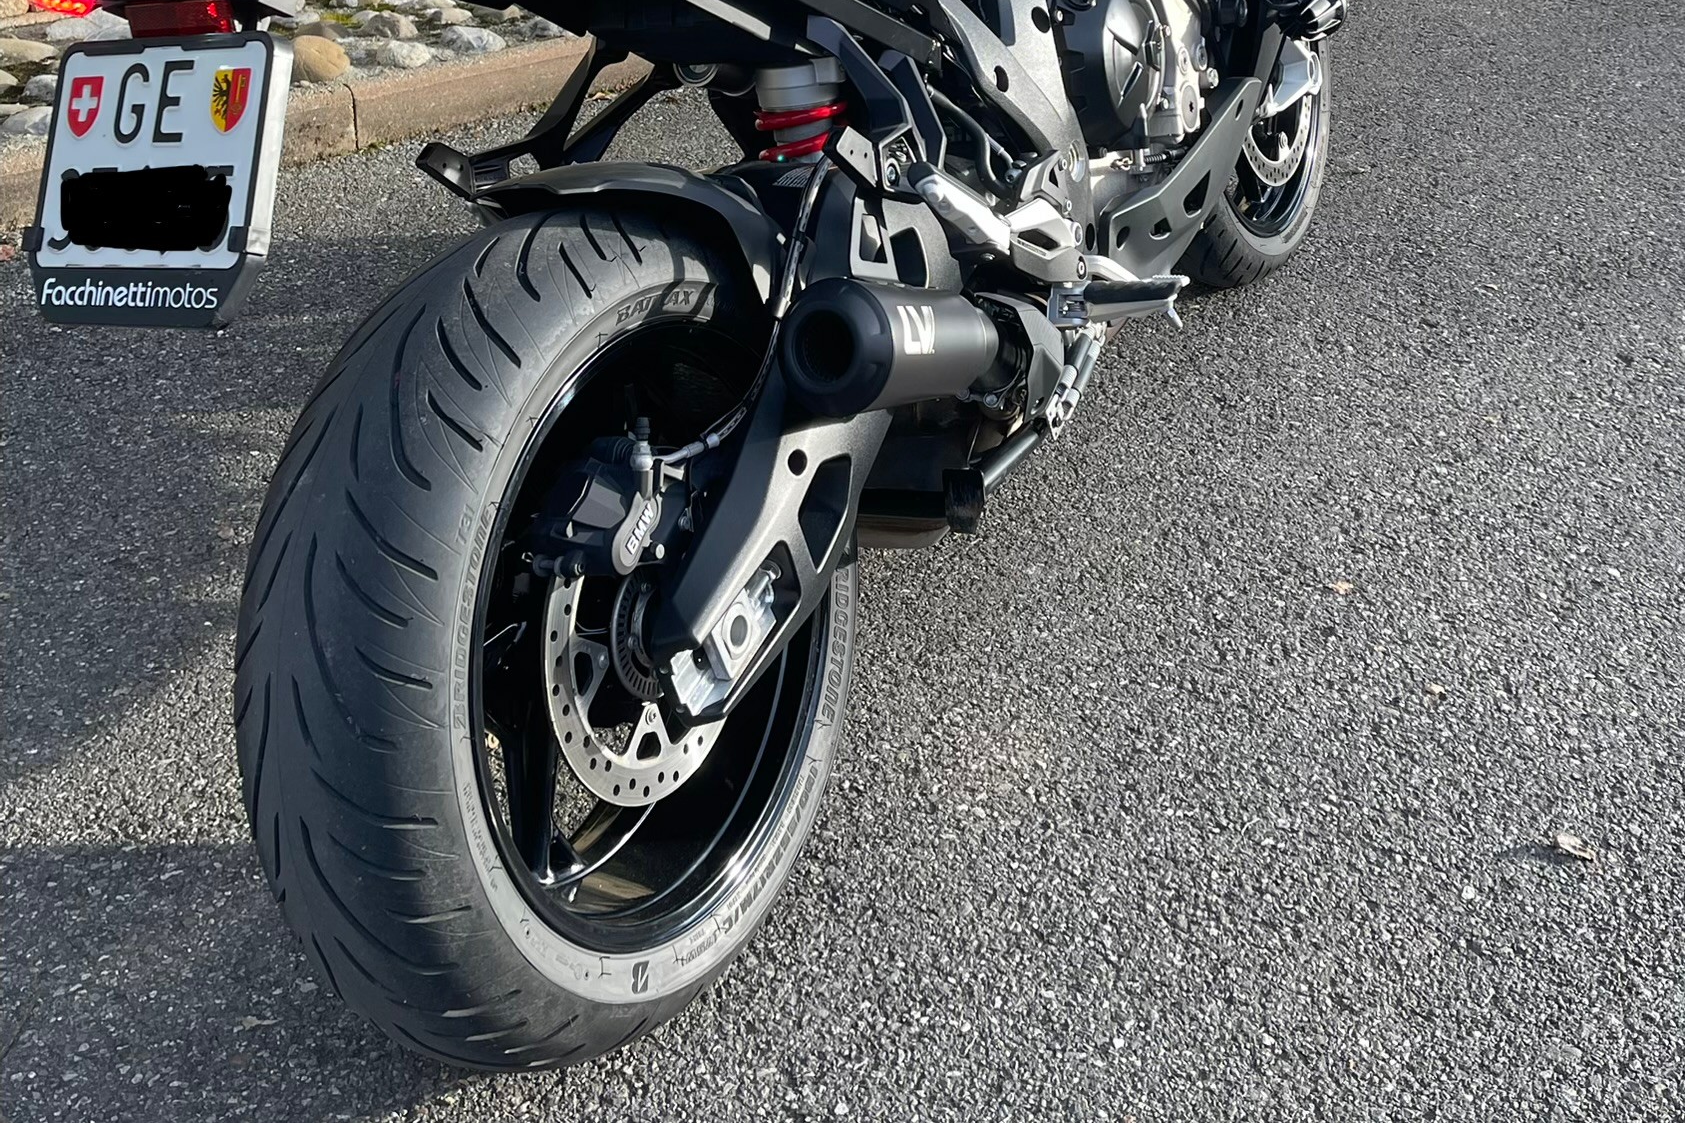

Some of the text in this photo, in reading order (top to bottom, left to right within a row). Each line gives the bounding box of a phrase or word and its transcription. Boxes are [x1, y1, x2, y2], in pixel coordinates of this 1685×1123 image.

[114, 59, 196, 144] GE
[41, 278, 218, 309] Facchinettimotos
[625, 502, 654, 555] BMW
[821, 568, 850, 724] RIDGESTONE
